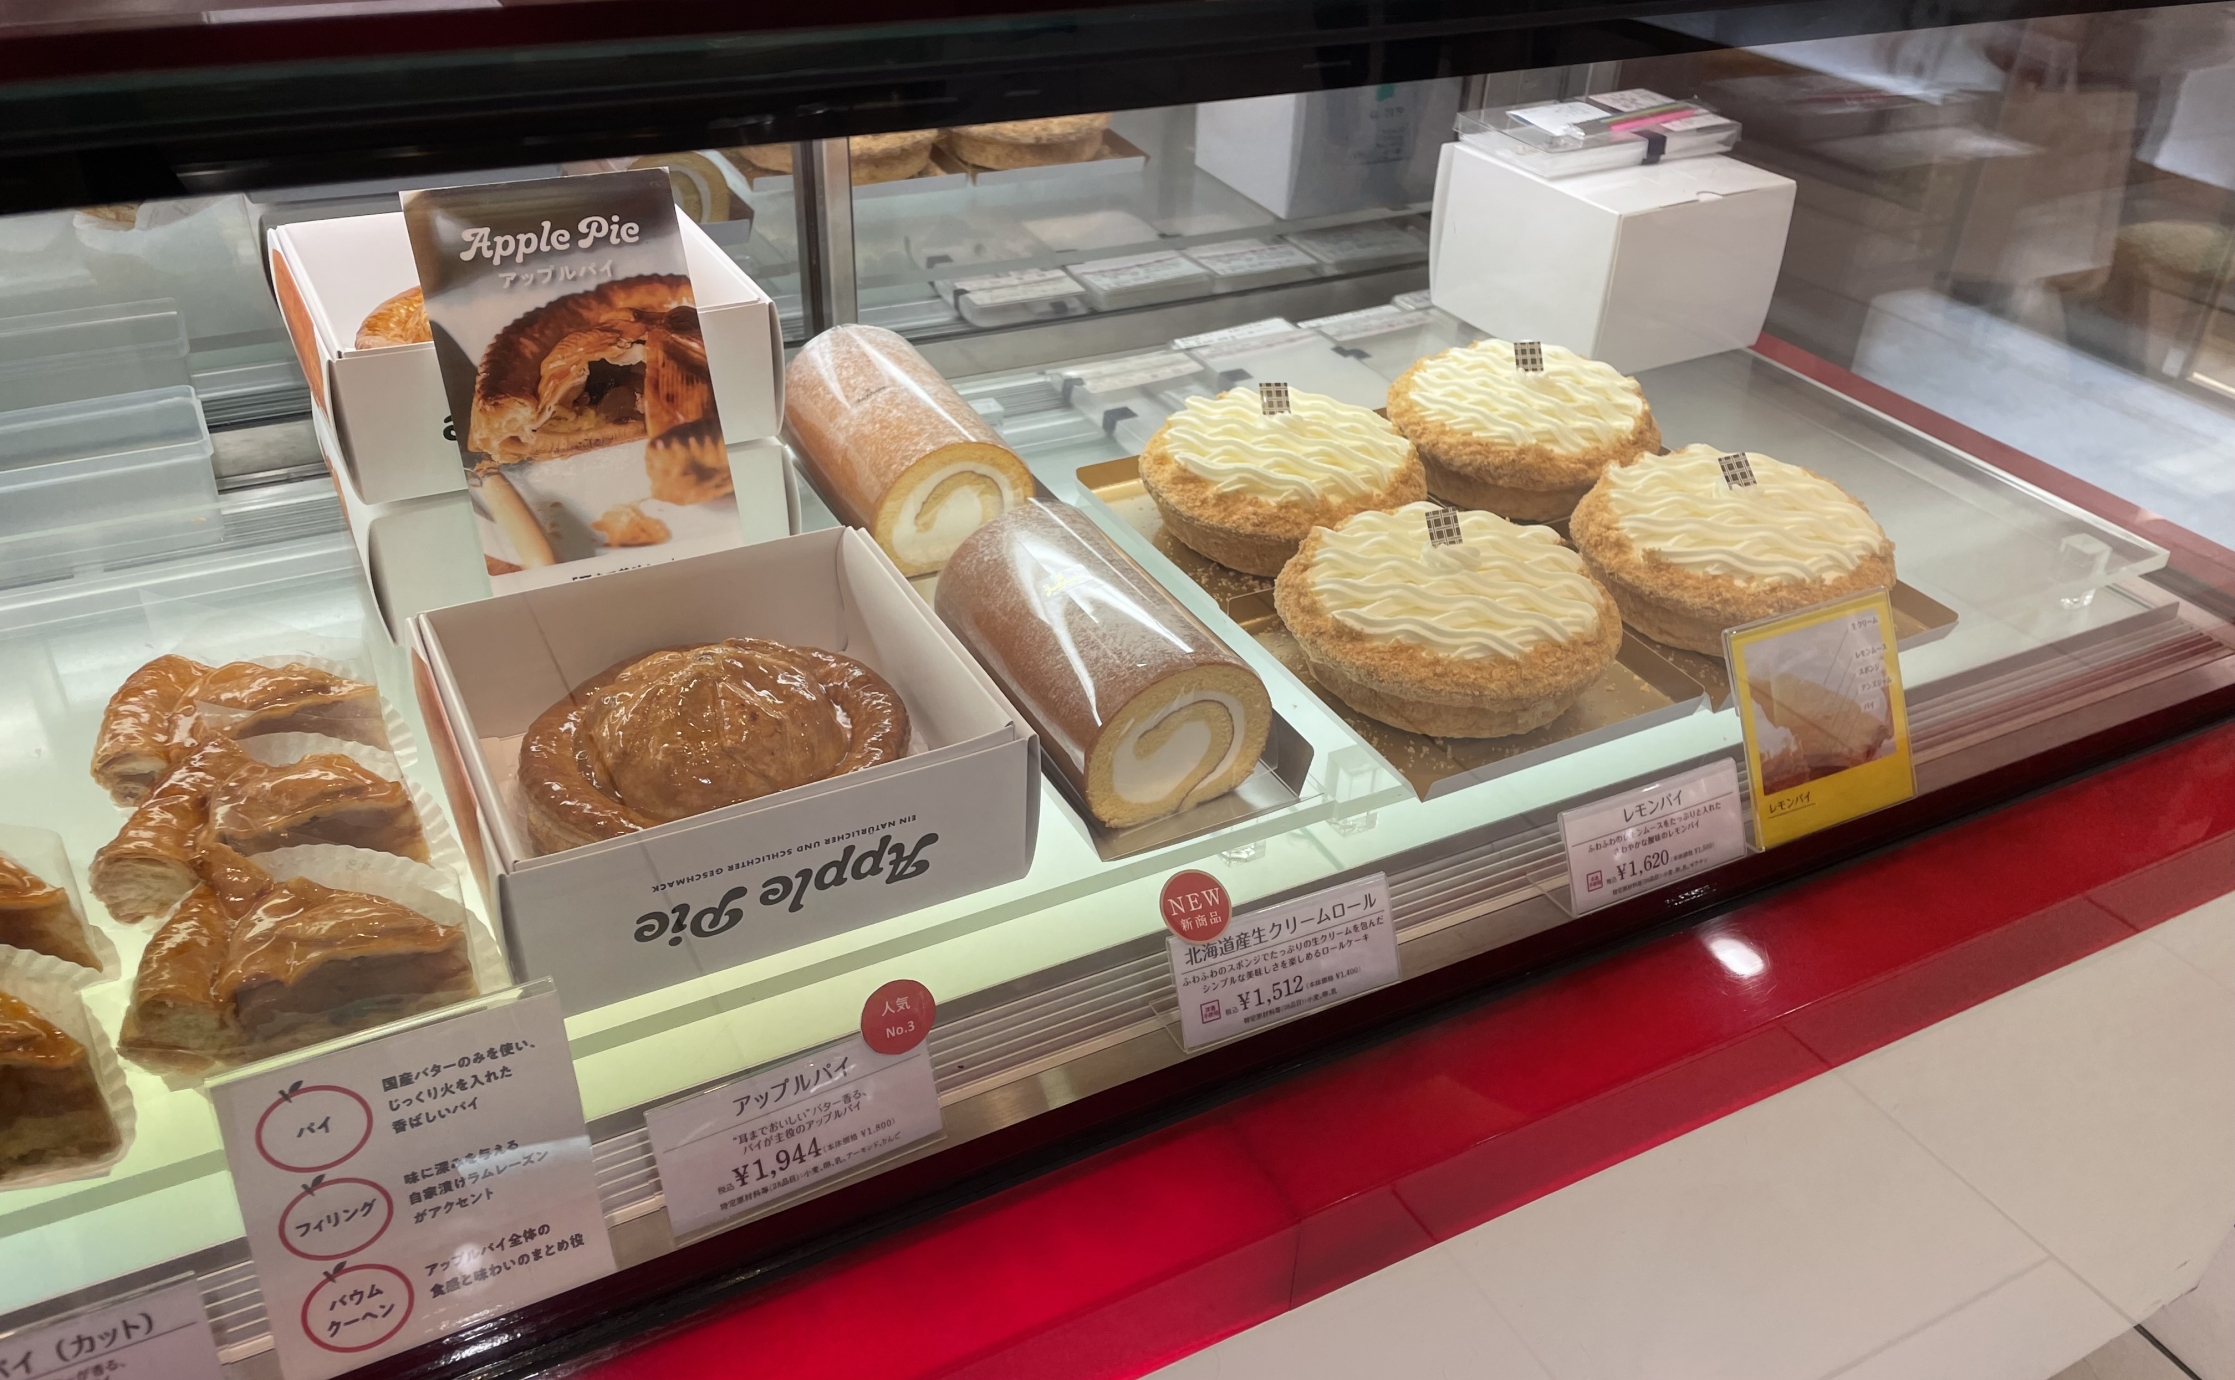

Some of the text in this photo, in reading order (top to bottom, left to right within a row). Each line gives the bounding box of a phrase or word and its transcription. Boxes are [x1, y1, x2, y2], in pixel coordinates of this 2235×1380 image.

[459, 215, 640, 265] Apple Pie
[499, 259, 615, 289] アップルパイ
[1622, 790, 1682, 823] レモンパイ
[1769, 791, 1810, 813] レモンパイ
[1588, 802, 1722, 853] ふわふわのレンムースをたっぷりと入れた
[651, 814, 917, 893] EIN NATÜRLICHER UND SCHLICHTER GESCHMACK
[1616, 849, 1669, 881] ¥1,620
[634, 832, 939, 946] Apple Pie
[1167, 887, 1221, 917] NEW
[1180, 910, 1222, 932] 新商品
[1184, 892, 1377, 967] 北海道産生クリームロール
[1182, 914, 1384, 987] ふわふわのスポンジでたっぷりの生クリームを包んだ
[1202, 935, 1370, 994] シンプルな美味しさを楽しめるロールケーキ
[881, 996, 911, 1017] 人気
[1237, 974, 1304, 1011] ¥1,512
[886, 1020, 916, 1038] No.3
[382, 1041, 536, 1093] 国産バターのみを使い、
[387, 1064, 513, 1112] じっくり火を入れた
[732, 1056, 848, 1117] アップルパイ
[296, 1116, 332, 1139] パイ
[391, 1097, 479, 1135] 香ばしいパイ
[403, 1139, 519, 1185] 味に深みを与える
[408, 1150, 549, 1205] 自家漬けラムレーズン
[717, 1183, 735, 1195] 税込
[731, 1136, 822, 1188] ¥1,944
[295, 1198, 378, 1239] フィリング
[413, 1187, 494, 1224] がアクセント
[424, 1223, 551, 1277] アップルパイ全体の
[429, 1232, 585, 1299] 食感と味わいのまとめ役
[328, 1284, 384, 1312] バウム
[326, 1303, 396, 1338] クーヘン
